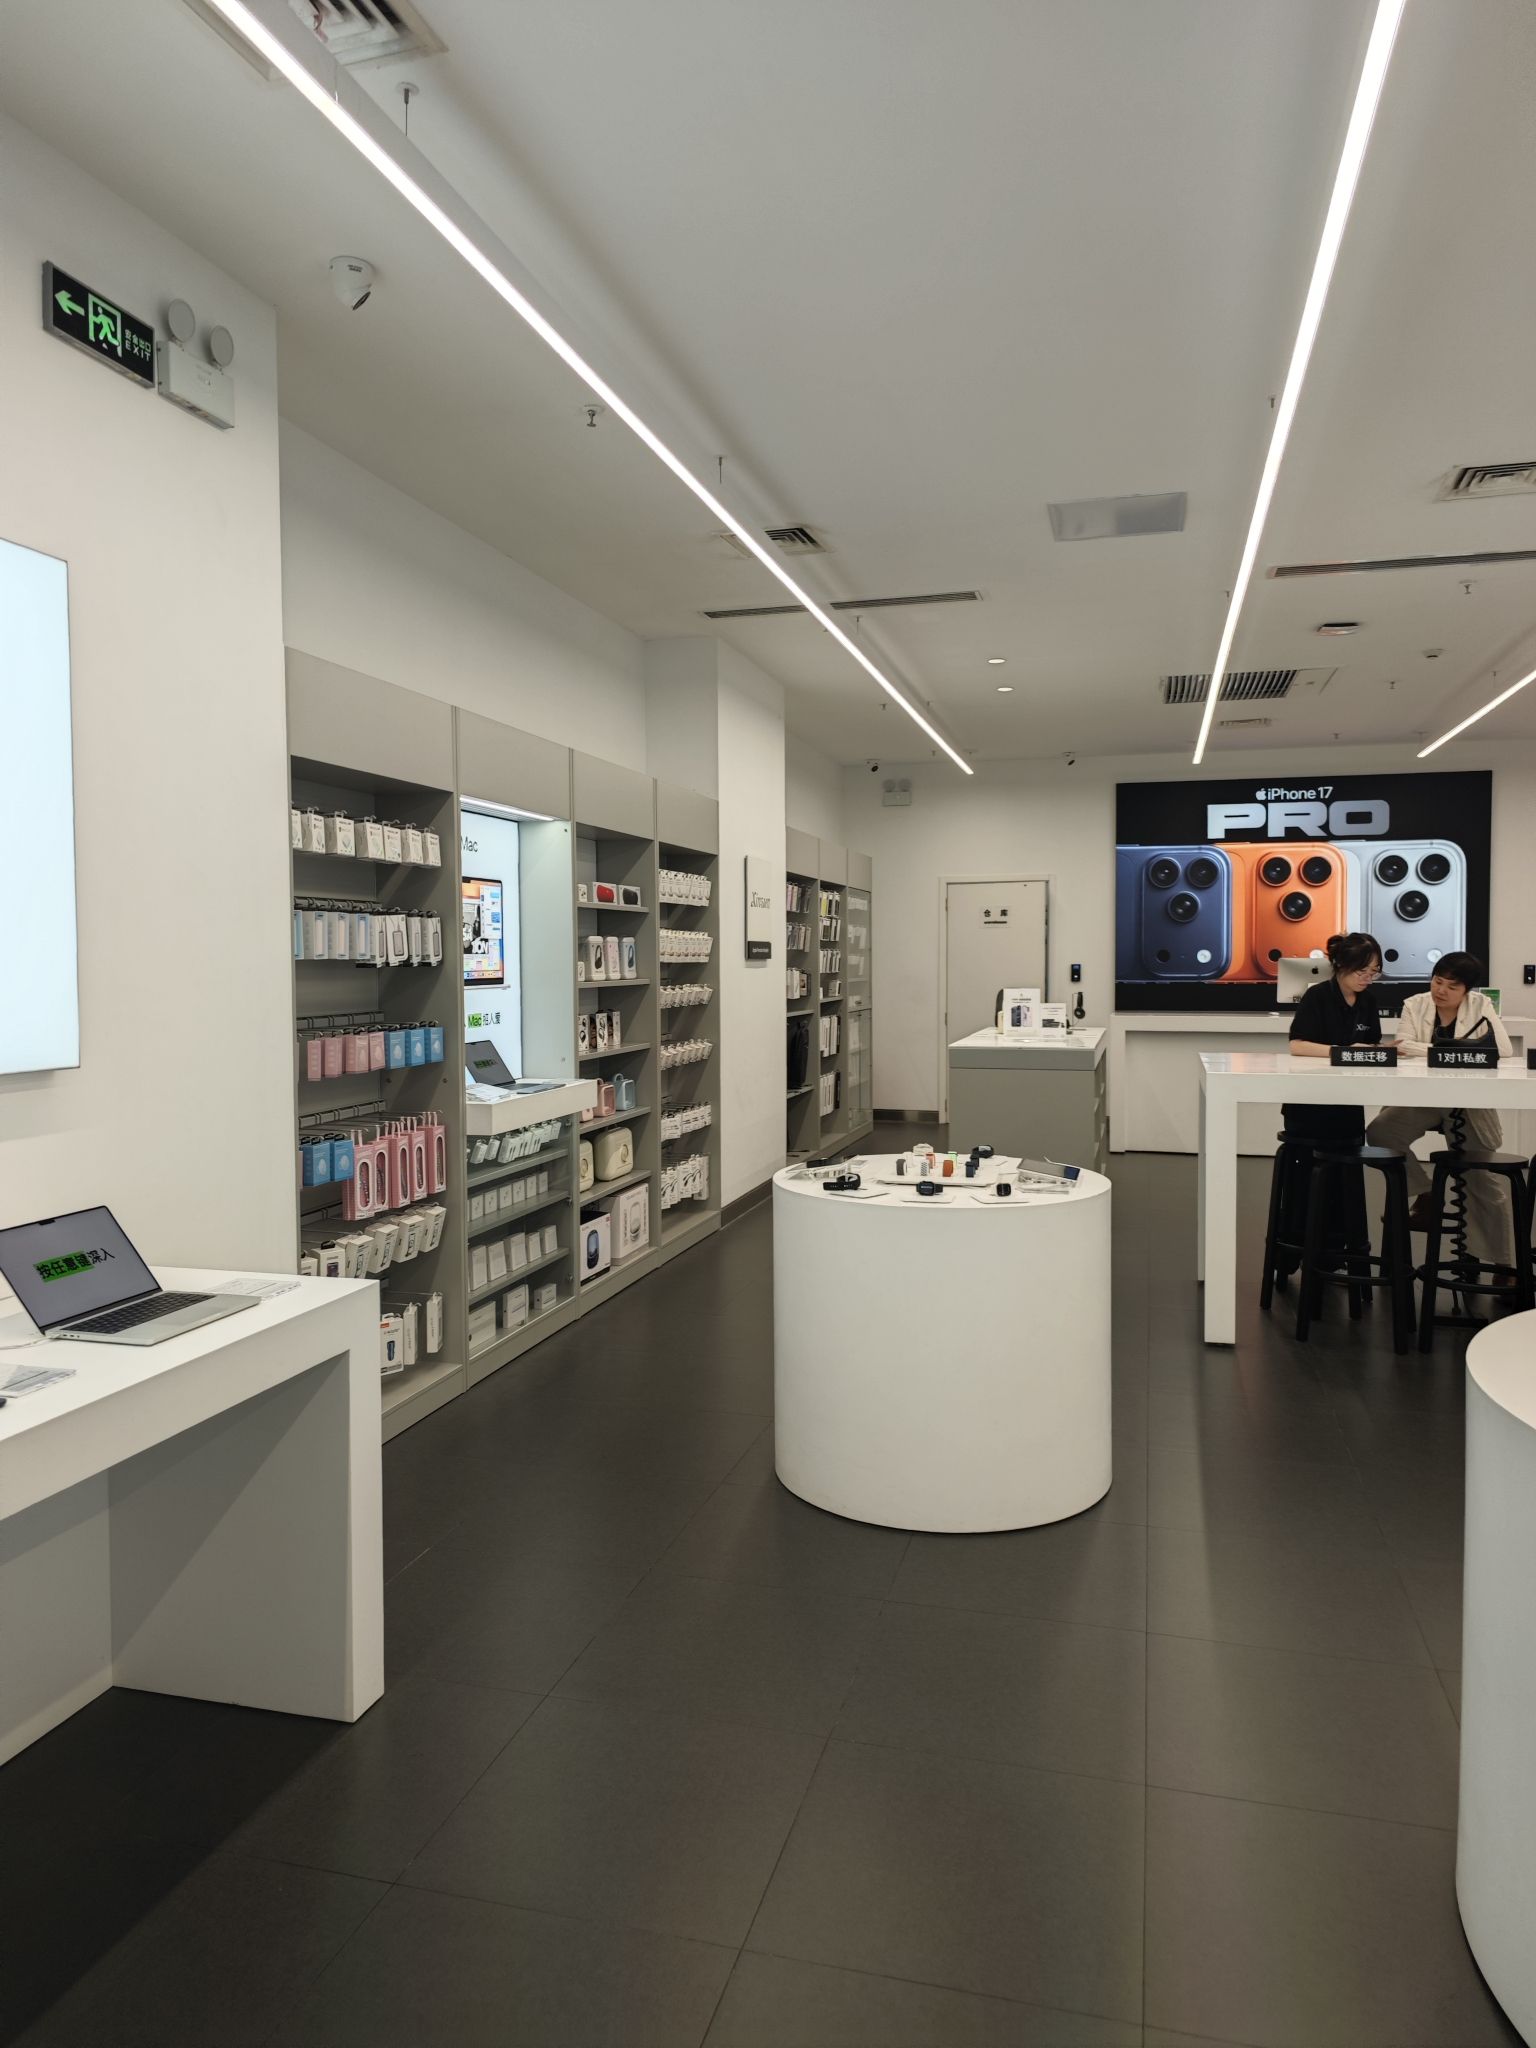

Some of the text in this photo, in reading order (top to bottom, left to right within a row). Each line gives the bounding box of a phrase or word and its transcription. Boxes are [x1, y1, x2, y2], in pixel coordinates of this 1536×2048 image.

[125, 340, 151, 361] EXIT
[1267, 786, 1334, 800] iPhone 17
[1207, 800, 1390, 839] PRO
[1341, 1050, 1388, 1063] 数据迁移
[1437, 1052, 1488, 1064] 1对1私教
